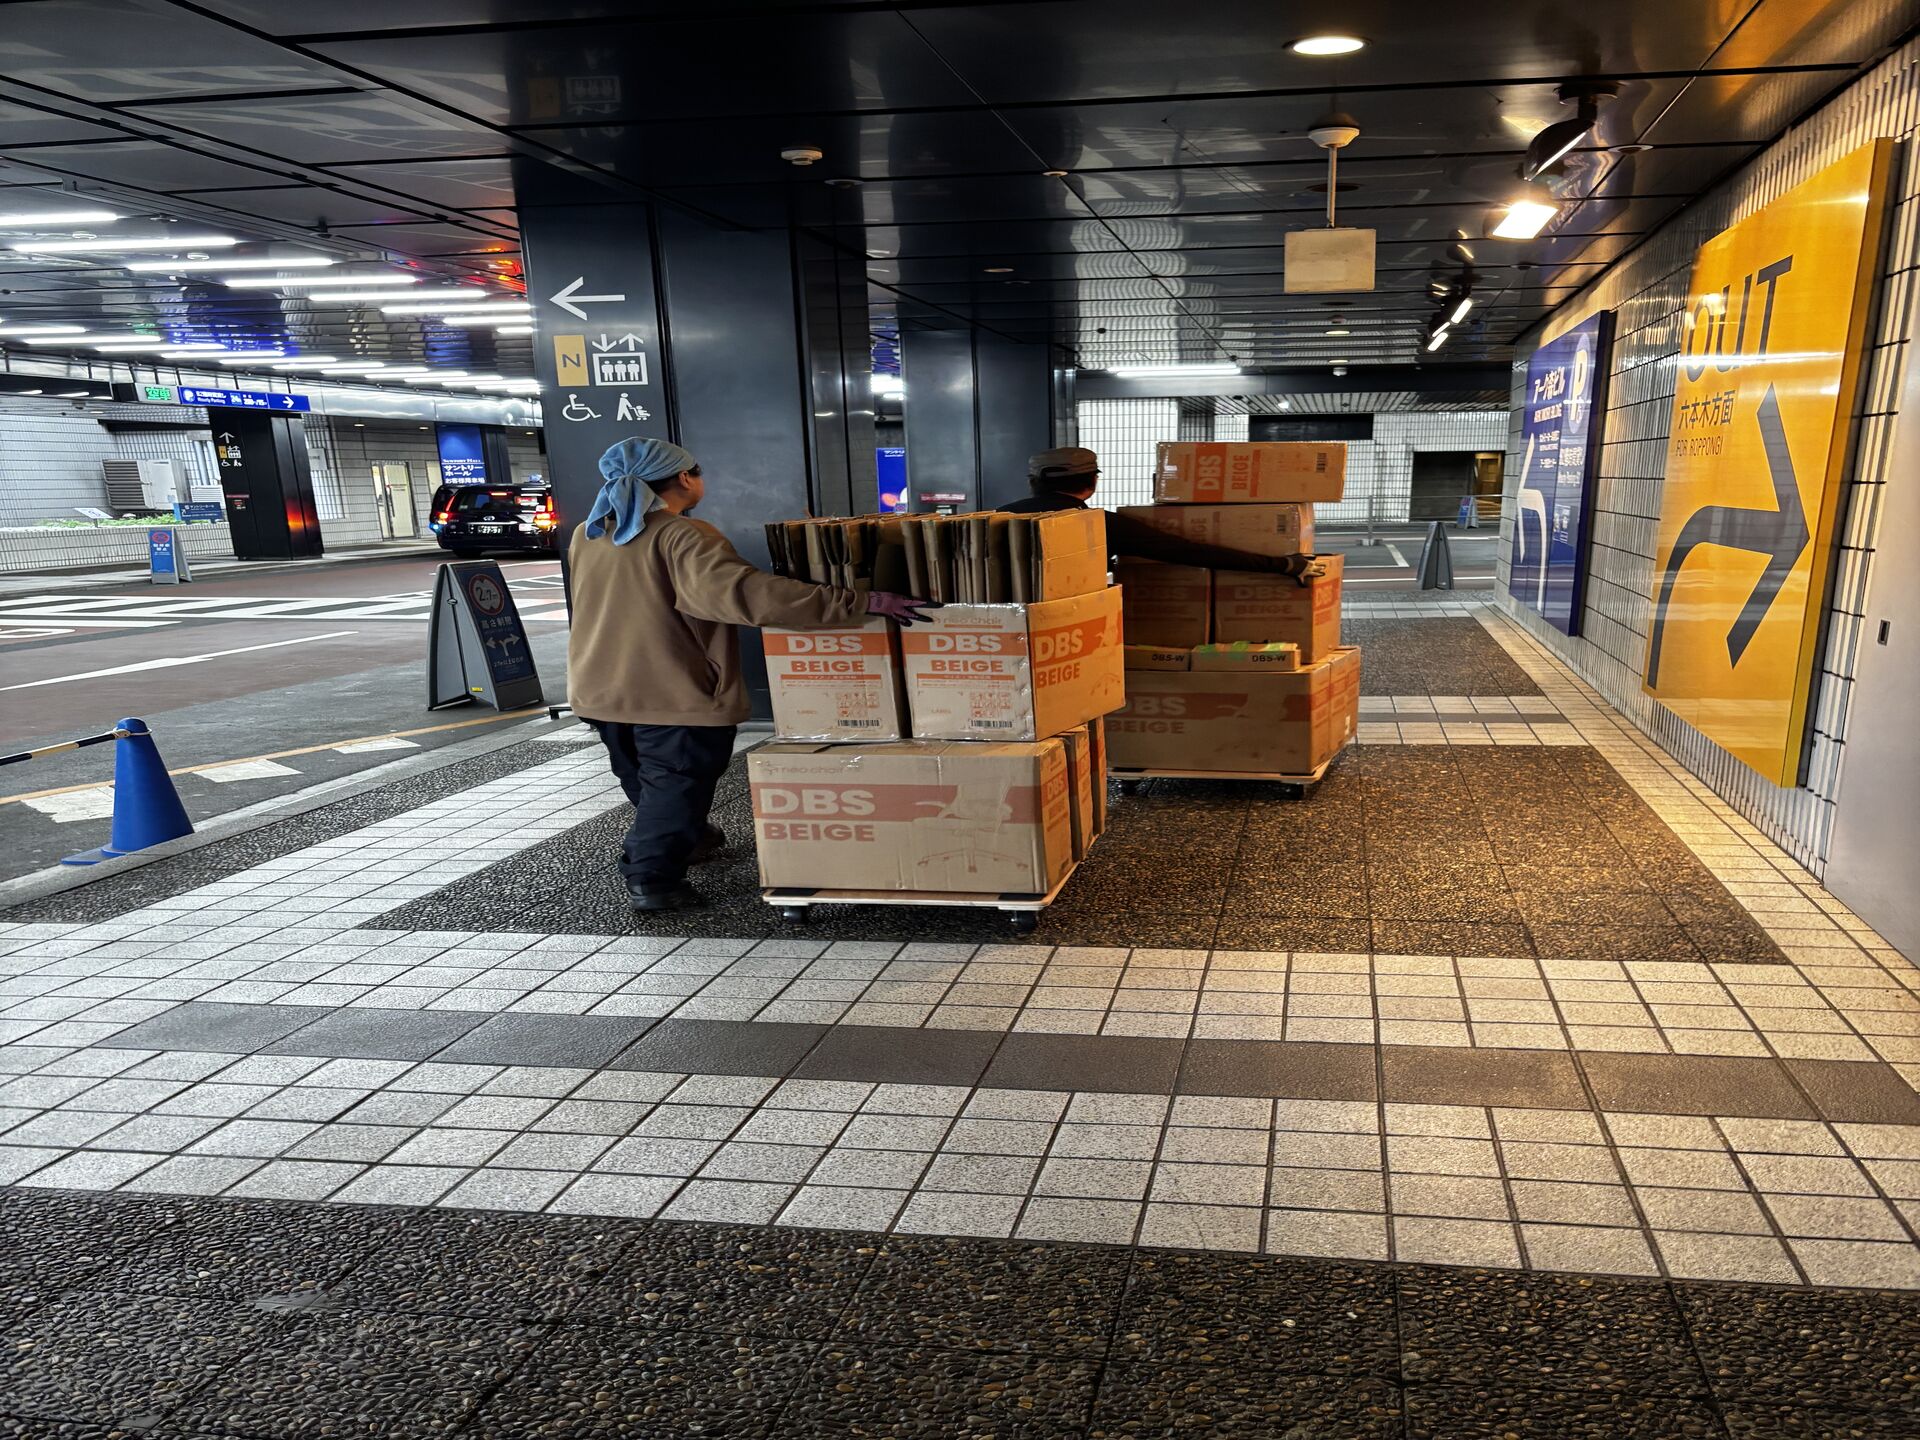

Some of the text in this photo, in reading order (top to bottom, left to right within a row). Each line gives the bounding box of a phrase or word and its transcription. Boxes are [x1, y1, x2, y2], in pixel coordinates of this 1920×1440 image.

[1685, 254, 1794, 383] OUT
[561, 352, 582, 368] N
[1678, 389, 1736, 430] 六本木方面
[1675, 435, 1724, 457] FOR ROPPONGI
[1199, 455, 1223, 491] DBS
[1231, 454, 1250, 491] BEIGE
[1234, 586, 1292, 600] DBS
[786, 635, 864, 653] DBS
[928, 634, 1002, 653] DBS
[1034, 628, 1084, 662] DBS
[790, 660, 865, 673] BEIGE
[931, 659, 1004, 673] BEIGE
[1251, 653, 1287, 663] DBS-W
[1036, 662, 1081, 689] BEIGE
[759, 788, 876, 816] DBS
[763, 822, 876, 842] BEIGE
